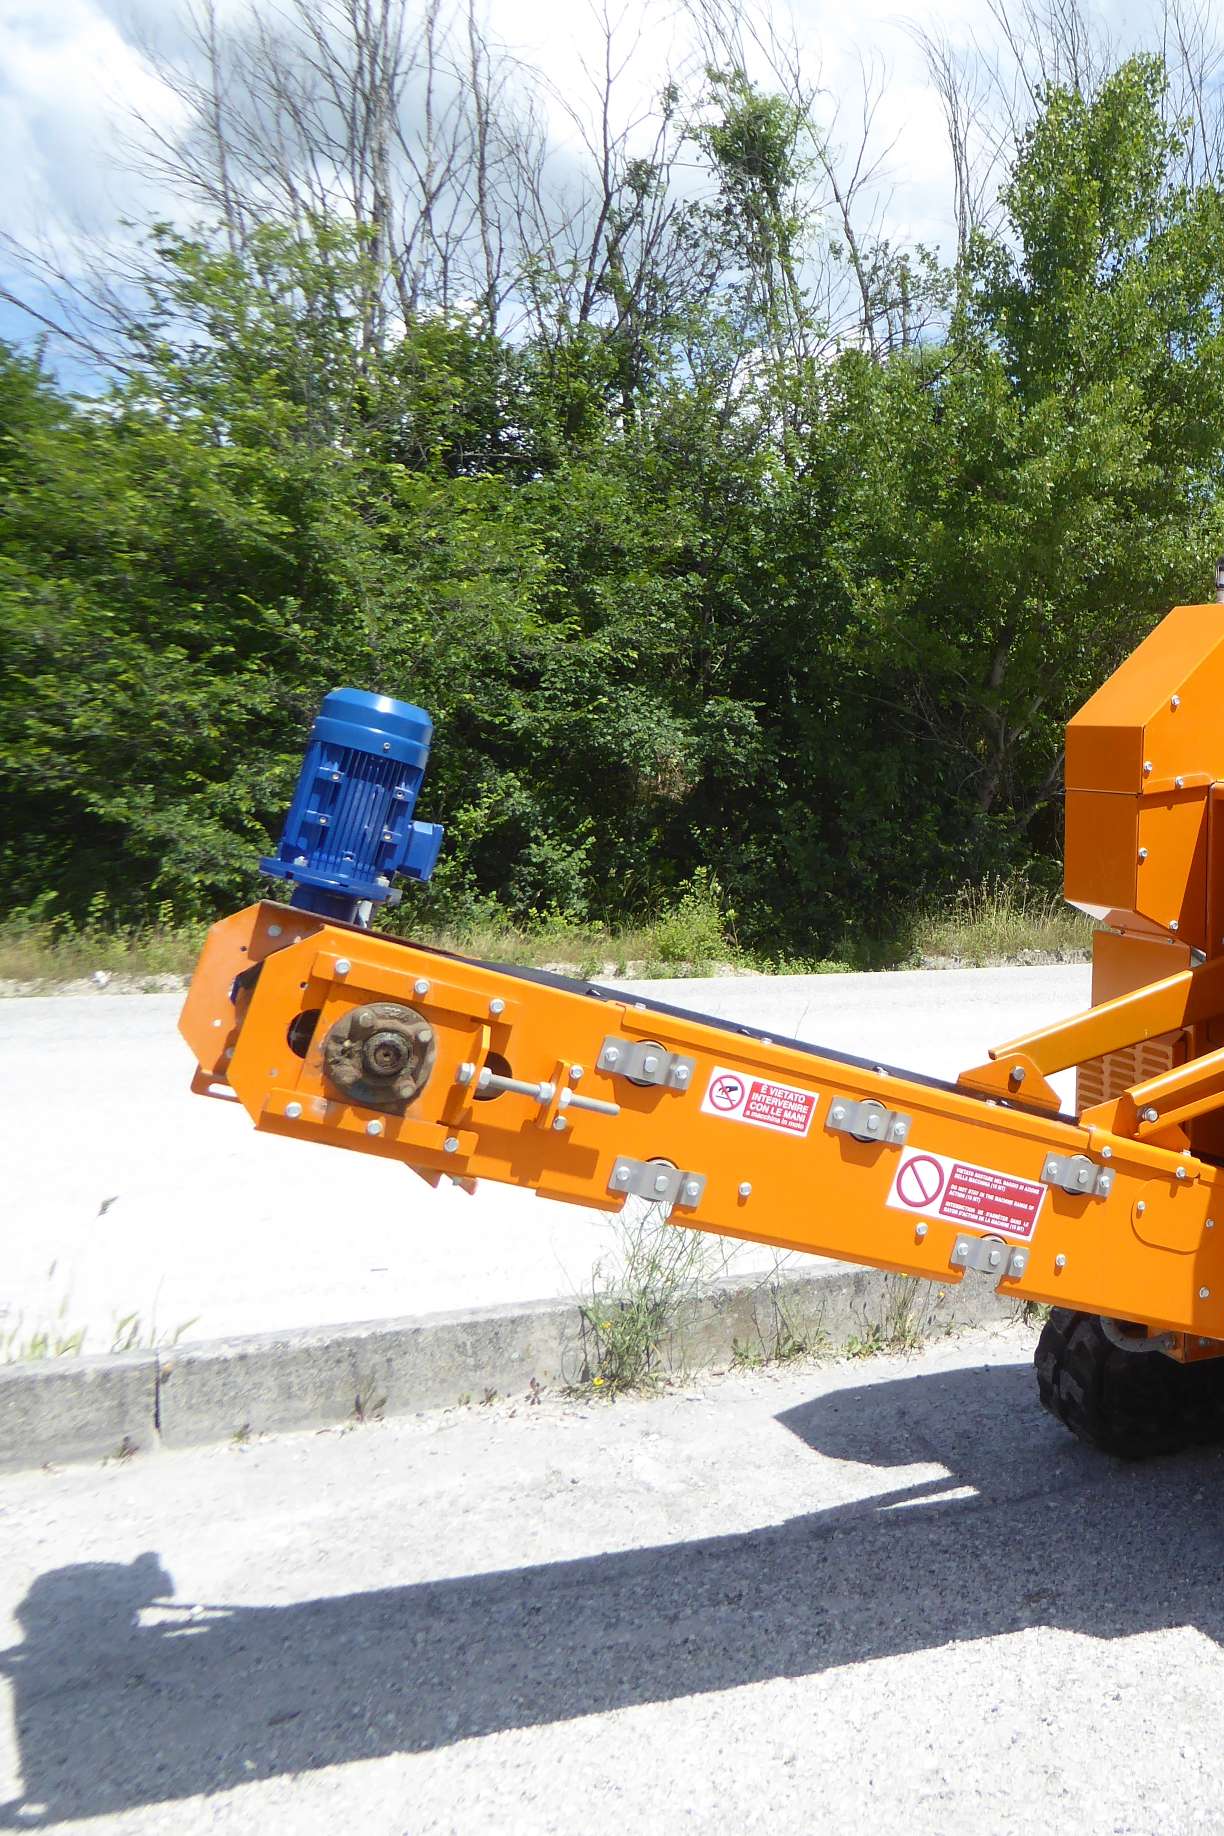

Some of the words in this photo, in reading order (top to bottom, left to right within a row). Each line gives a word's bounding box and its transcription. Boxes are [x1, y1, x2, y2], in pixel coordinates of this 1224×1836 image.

[752, 1092, 808, 1113] INTERVENIRE
[770, 1087, 805, 1103] VIETATO
[750, 1101, 769, 1113] CON
[770, 1106, 782, 1117] LE
[783, 1109, 806, 1123] MANI
